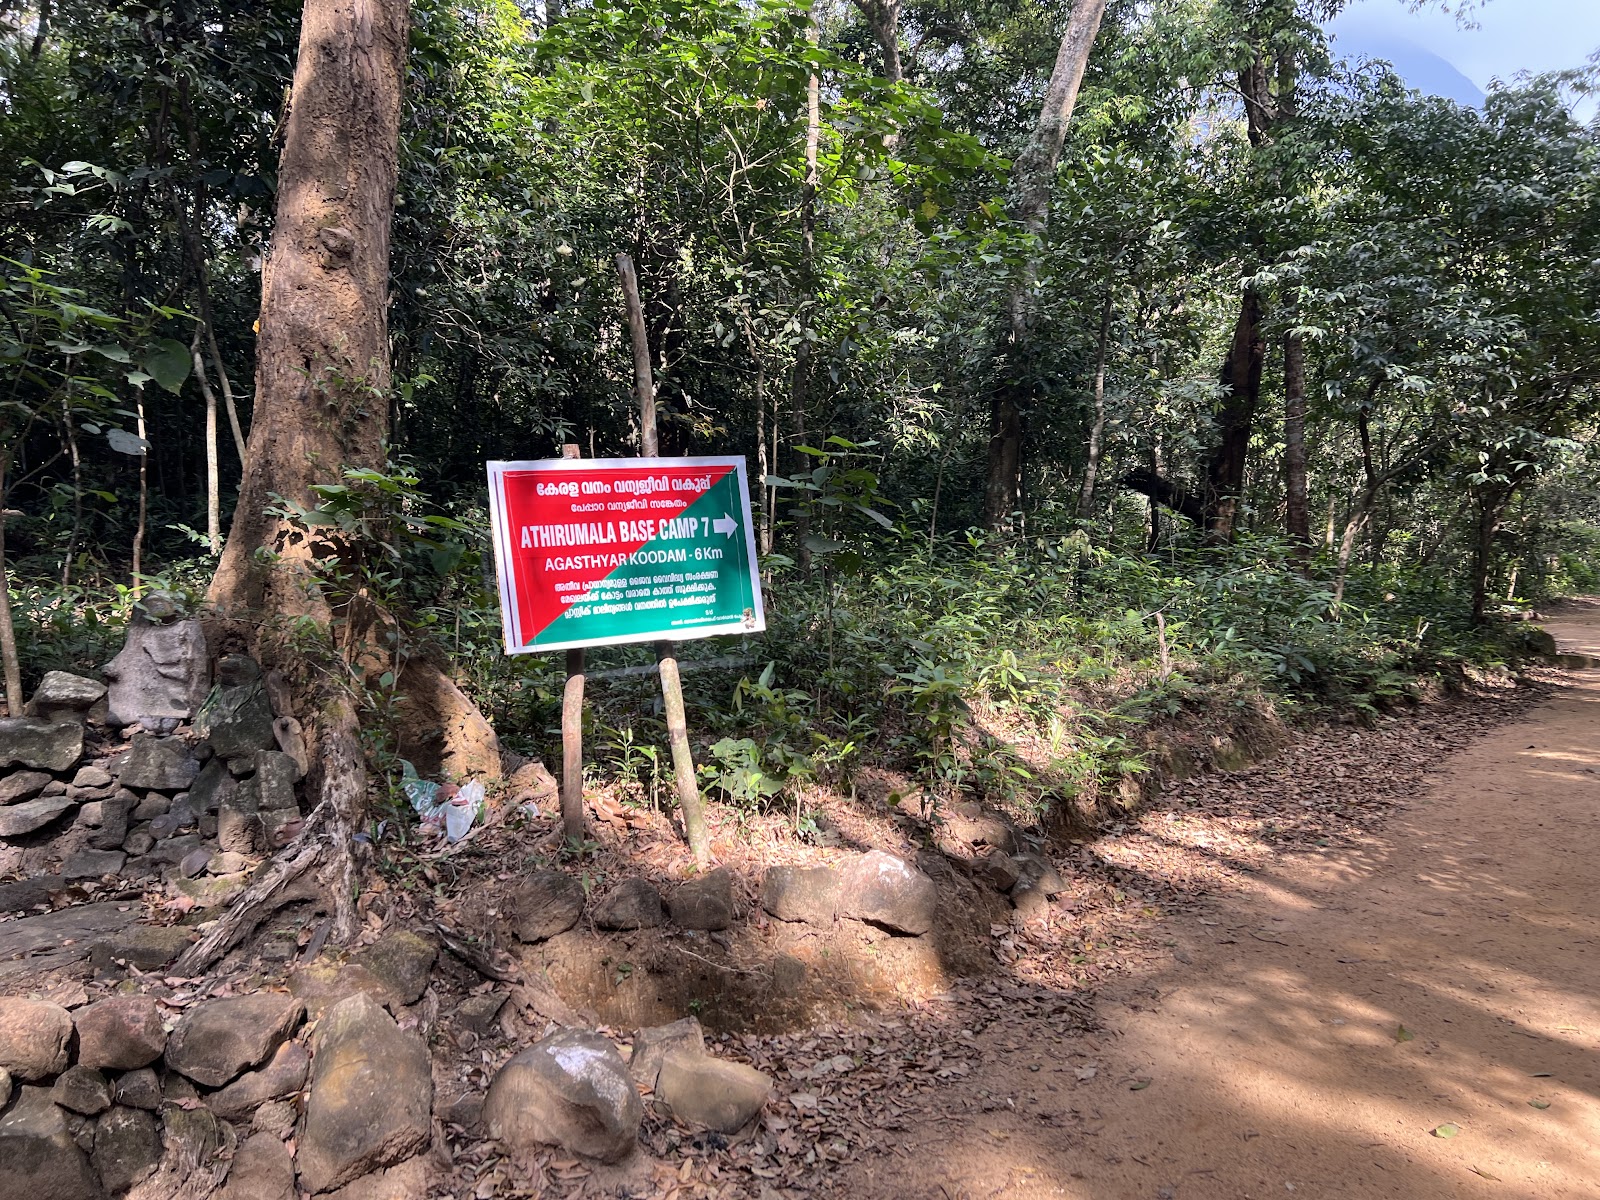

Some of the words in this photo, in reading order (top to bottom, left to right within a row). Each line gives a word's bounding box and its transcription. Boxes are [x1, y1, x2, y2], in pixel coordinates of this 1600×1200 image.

[536, 482, 579, 497] കേരള
[581, 480, 611, 494] വനം
[571, 502, 604, 513] പേപ്പാറ
[608, 499, 648, 513] വന്യജീവി
[650, 499, 687, 509] സങ്കേതം
[521, 522, 616, 548] ATHIRUMALA
[619, 519, 656, 542] BASE
[659, 518, 698, 540] CAMP
[701, 517, 709, 537] 7
[545, 553, 627, 571] AGASTHYAR
[629, 549, 686, 567] KOODAM
[695, 548, 702, 560] 6
[703, 547, 723, 560] Km
